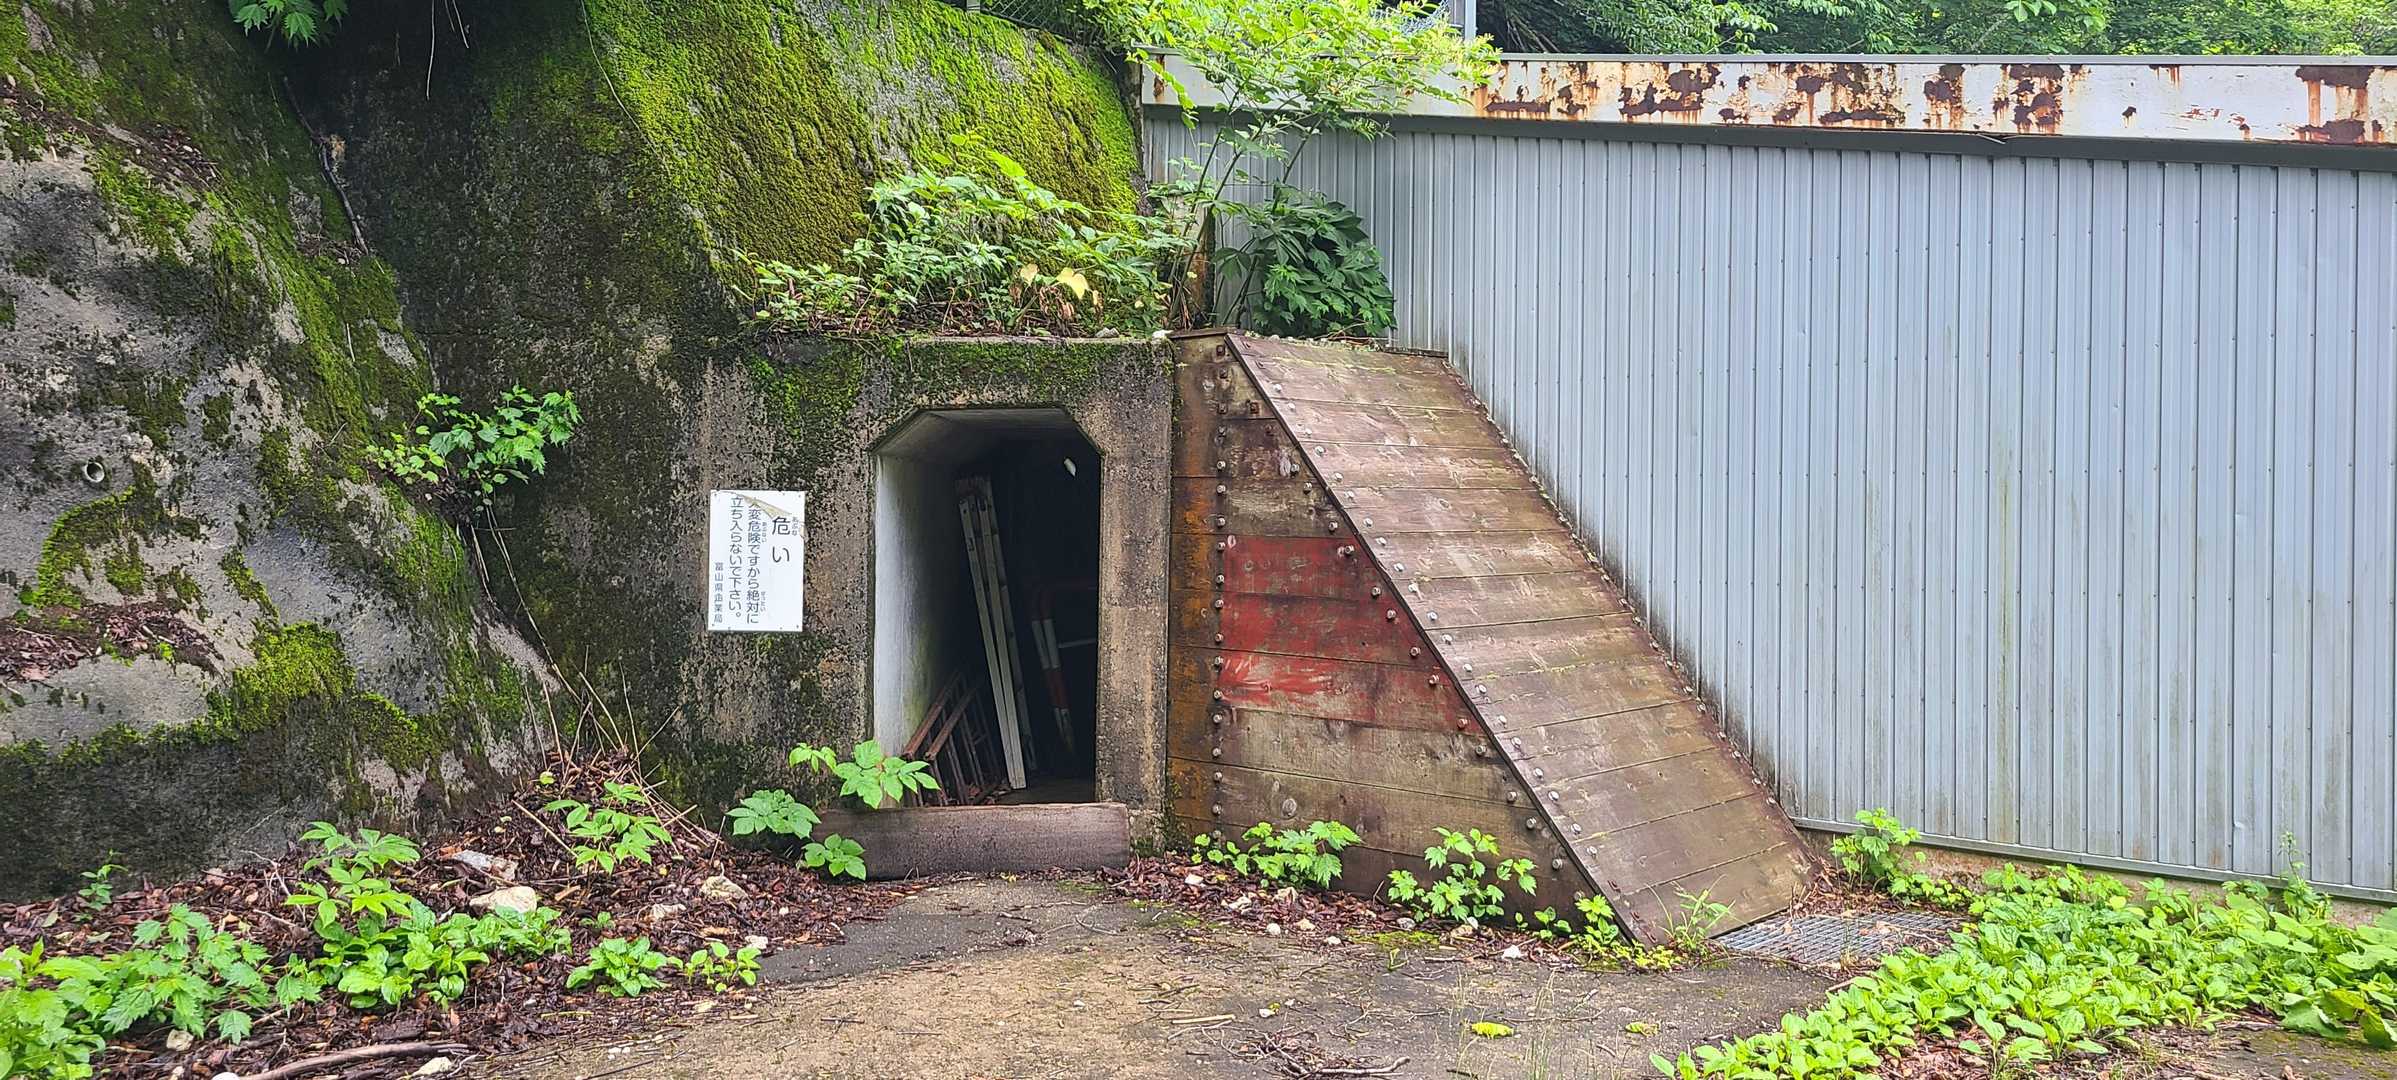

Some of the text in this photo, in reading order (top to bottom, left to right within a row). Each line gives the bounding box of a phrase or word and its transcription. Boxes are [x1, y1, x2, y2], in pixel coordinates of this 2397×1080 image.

[728, 496, 744, 618] 立ち入らないで下さい。
[772, 516, 791, 563] 危い
